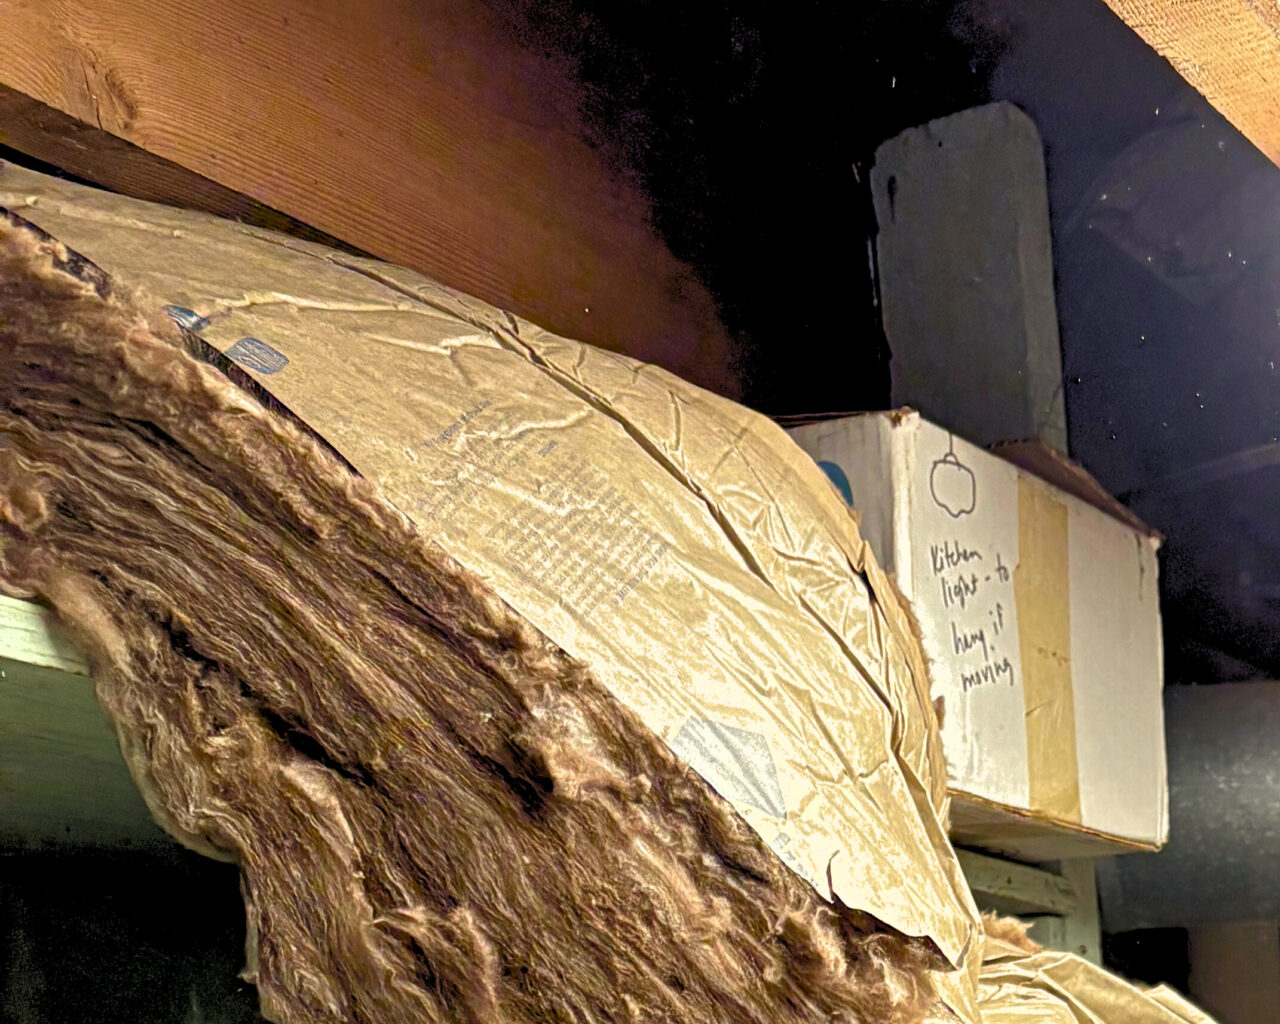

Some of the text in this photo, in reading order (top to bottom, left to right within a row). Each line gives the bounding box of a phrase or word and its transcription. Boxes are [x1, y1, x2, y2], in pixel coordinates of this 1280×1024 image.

[930, 540, 982, 576] Kitchen
[941, 572, 978, 609] light
[995, 552, 1010, 582] to
[988, 602, 1004, 635] if
[960, 655, 1015, 692] moving
